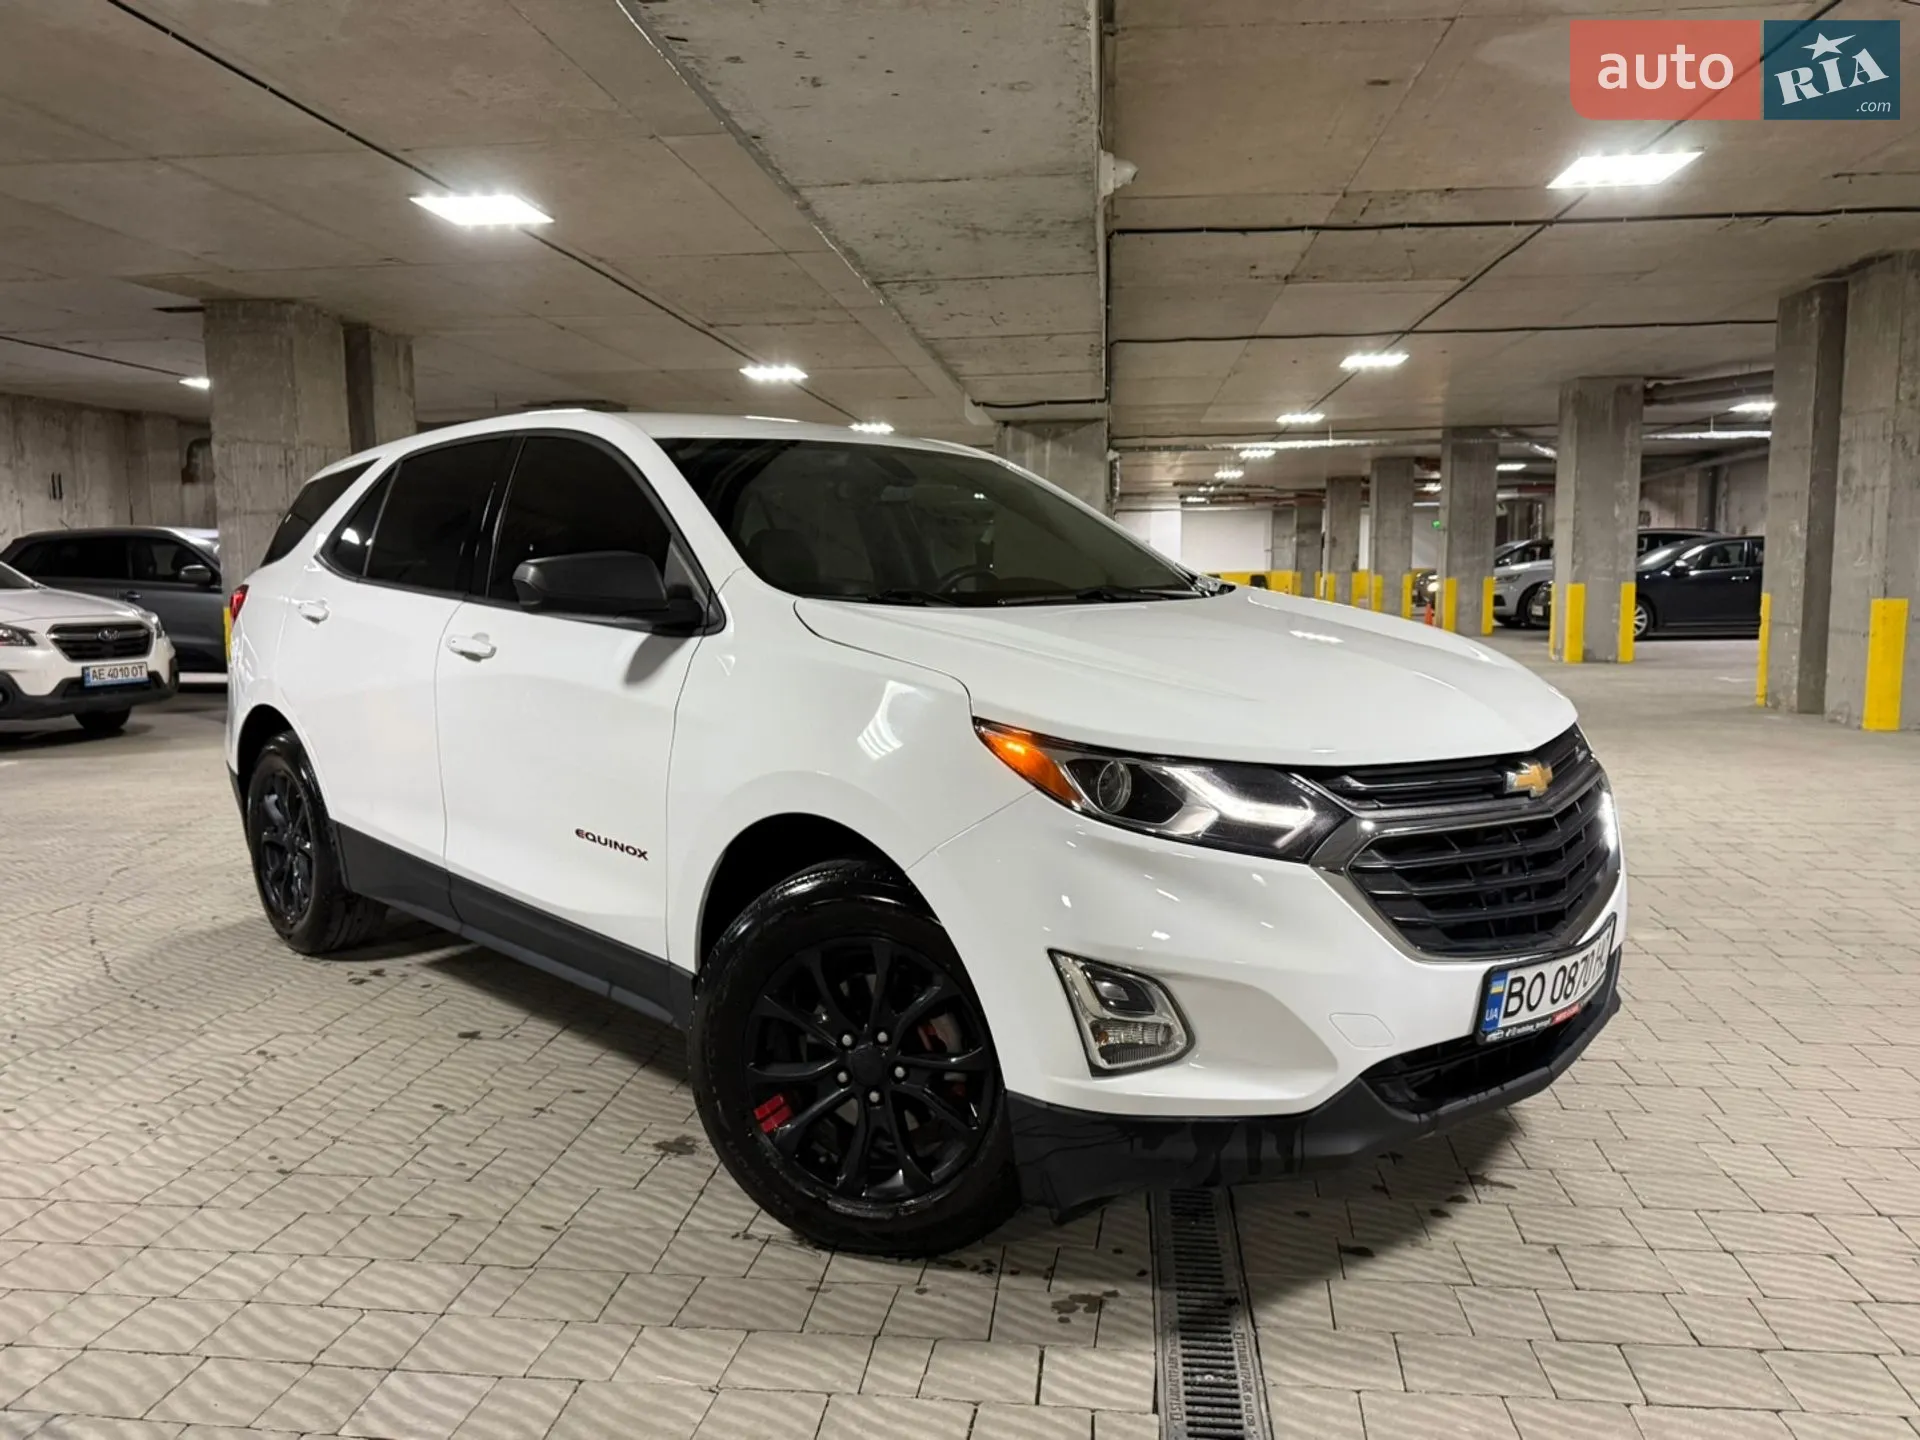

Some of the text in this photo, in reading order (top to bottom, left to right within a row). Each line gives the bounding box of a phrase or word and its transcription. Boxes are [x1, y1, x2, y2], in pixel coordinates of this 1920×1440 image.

[91, 668, 105, 681] AE
[107, 666, 130, 680] 4010
[574, 827, 648, 861] EQUINOX
[1502, 971, 1545, 1019] BO
[1550, 948, 1596, 1005] 0870
[1485, 1007, 1499, 1022] UA
